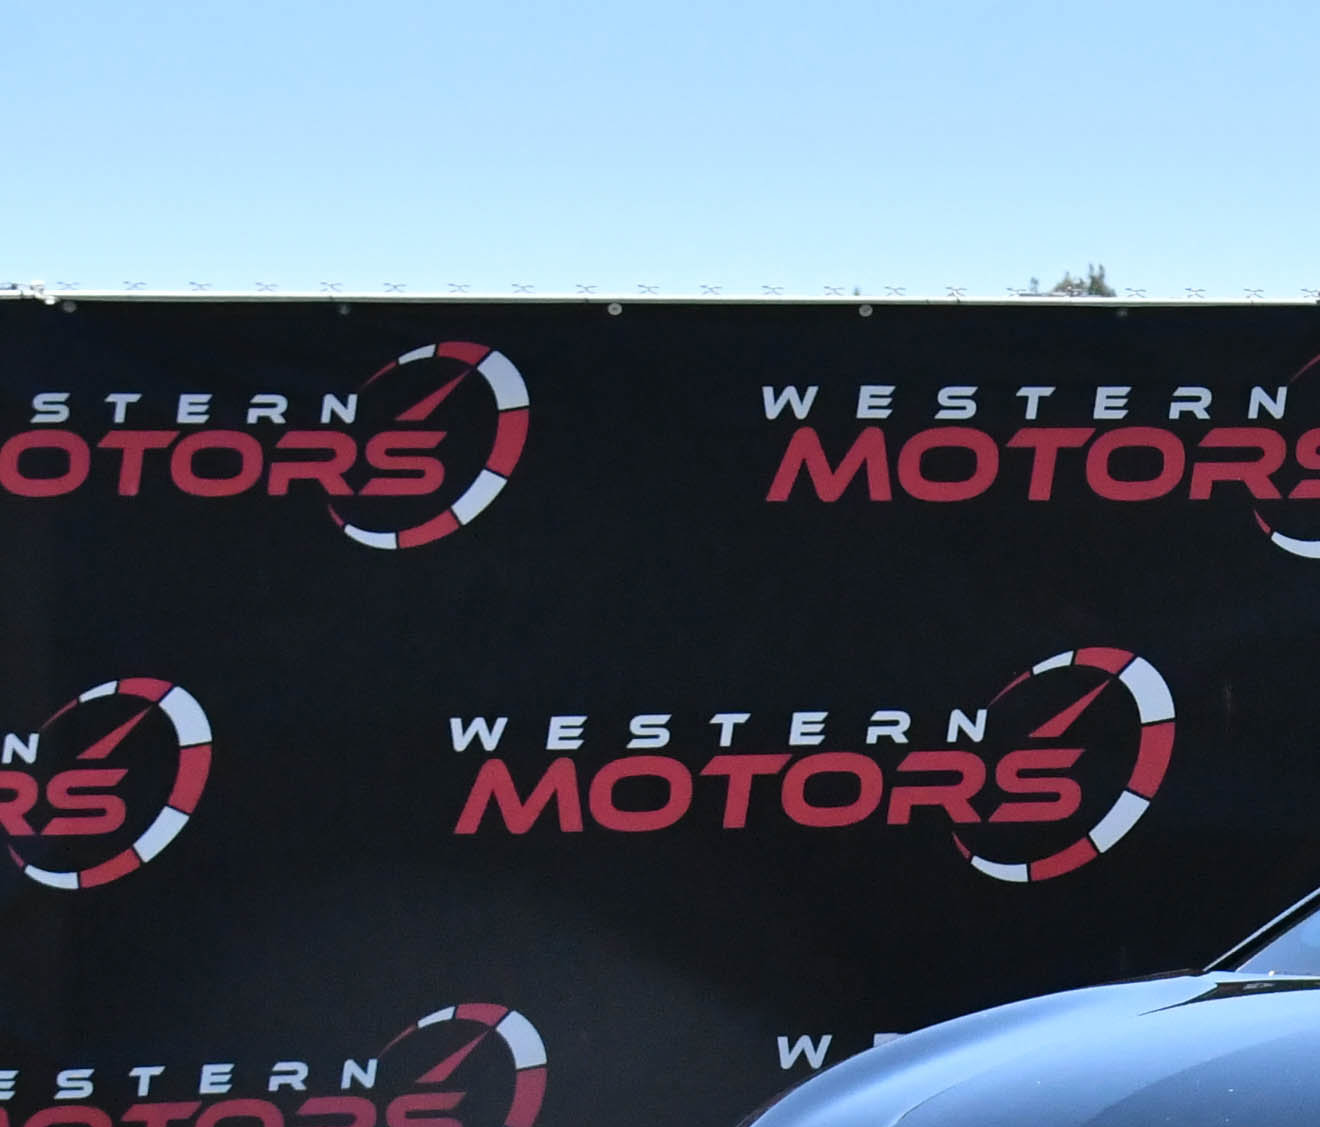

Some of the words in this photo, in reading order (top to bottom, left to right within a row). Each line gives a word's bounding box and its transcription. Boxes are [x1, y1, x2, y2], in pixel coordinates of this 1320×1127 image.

[31, 393, 358, 423] STERN
[763, 385, 1288, 419] WESTERN
[0, 429, 447, 497] OTORS
[450, 708, 988, 752] WESTERN
[453, 748, 1085, 835] MOTORS
[0, 1058, 378, 1100] ESTERN
